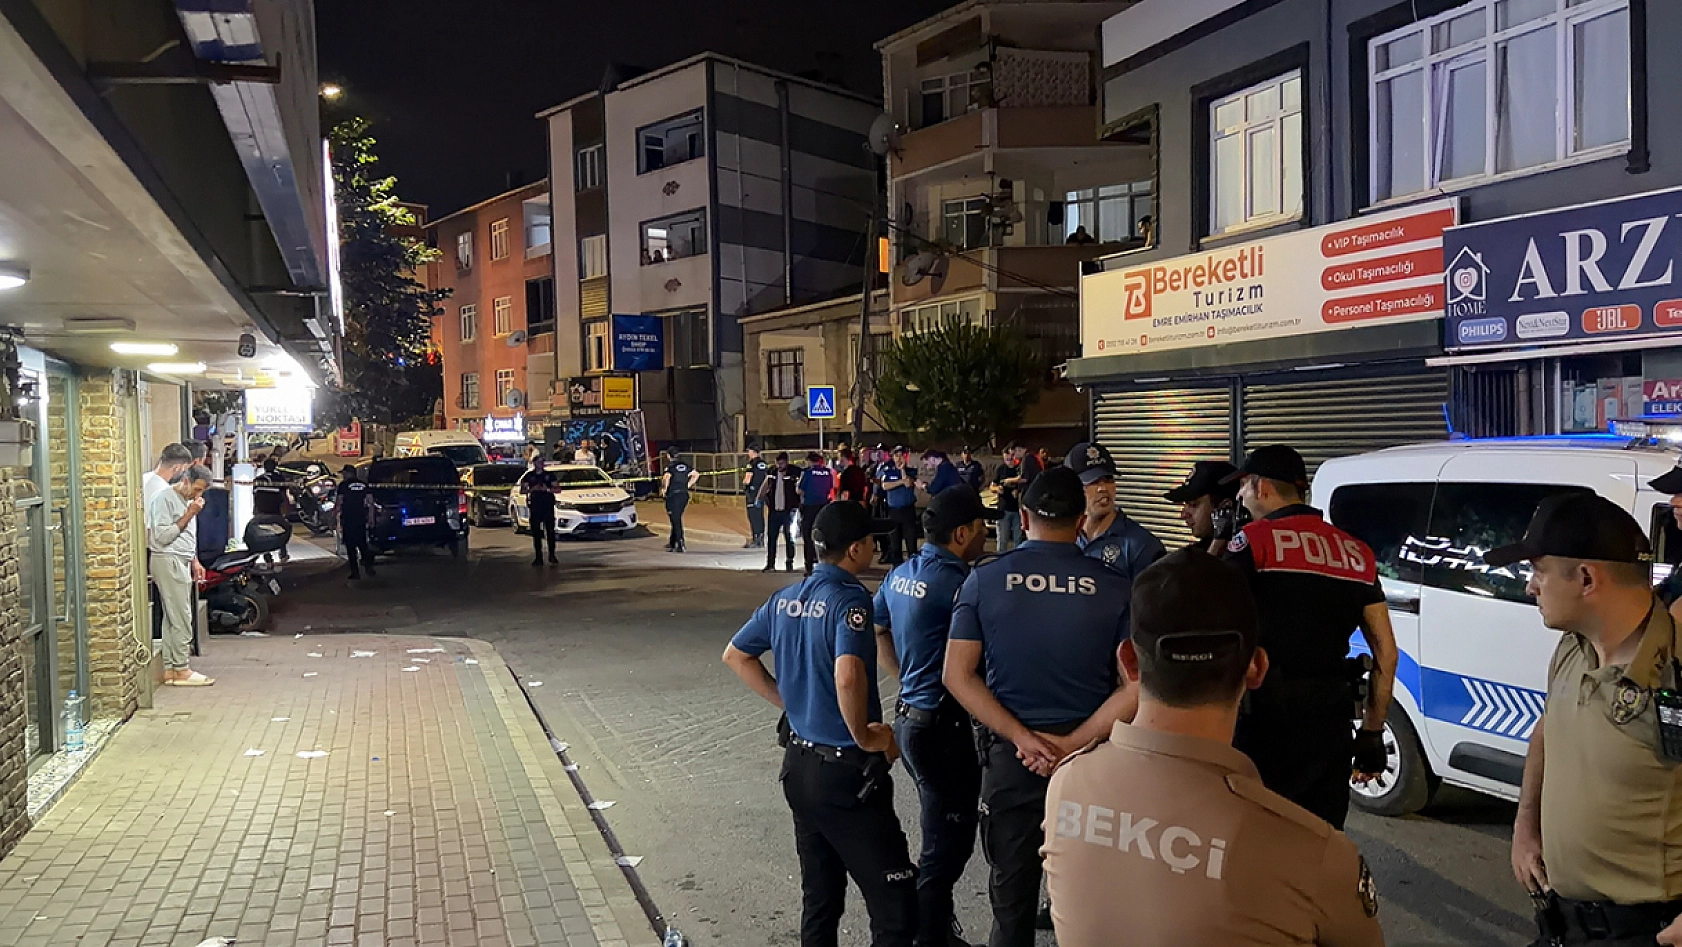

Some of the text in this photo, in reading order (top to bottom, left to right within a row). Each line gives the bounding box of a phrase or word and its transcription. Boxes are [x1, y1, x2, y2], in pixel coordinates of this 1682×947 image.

[1334, 226, 1404, 249] VIP Taşımacılık
[1508, 214, 1682, 302] ARZ
[1153, 246, 1264, 295] Bereketli
[1334, 260, 1414, 284] Okul Taşımacılığı
[1193, 283, 1264, 309] Turizm
[1334, 293, 1434, 317] Personel Taşımacılığı
[1152, 317, 1173, 328] EMRE
[1211, 302, 1264, 320] TAŞIMACILIK
[1447, 300, 1487, 317] HOME
[1596, 307, 1628, 330] JBL
[1666, 307, 1682, 319] Te
[1461, 322, 1504, 338] PHILIPS
[1652, 381, 1682, 399] Ar
